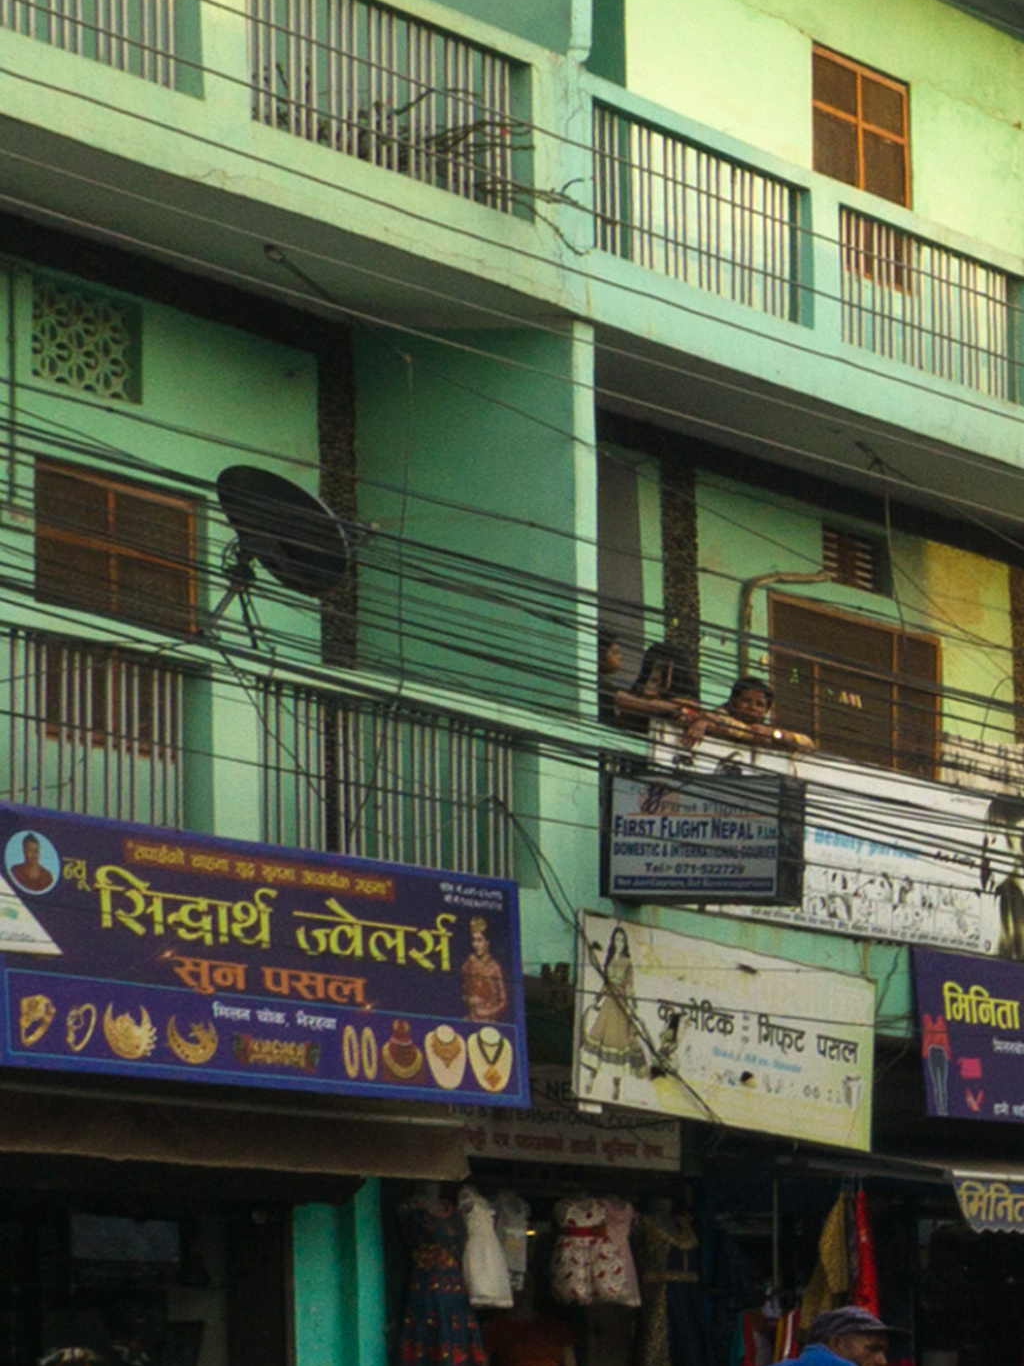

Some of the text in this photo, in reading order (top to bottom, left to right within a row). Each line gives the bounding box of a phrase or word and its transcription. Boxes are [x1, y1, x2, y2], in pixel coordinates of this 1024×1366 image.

[614, 815, 655, 838] FIRST
[660, 816, 709, 839] FLIGHT
[711, 818, 753, 841] NEPAL
[613, 841, 661, 857] DOMESTIC
[94, 864, 457, 972] सिद्धार्थ ज्वेलर्स
[173, 955, 367, 1004] सुन पसल
[943, 981, 1020, 1030] मिनिता
[816, 1035, 859, 1065] पसल
